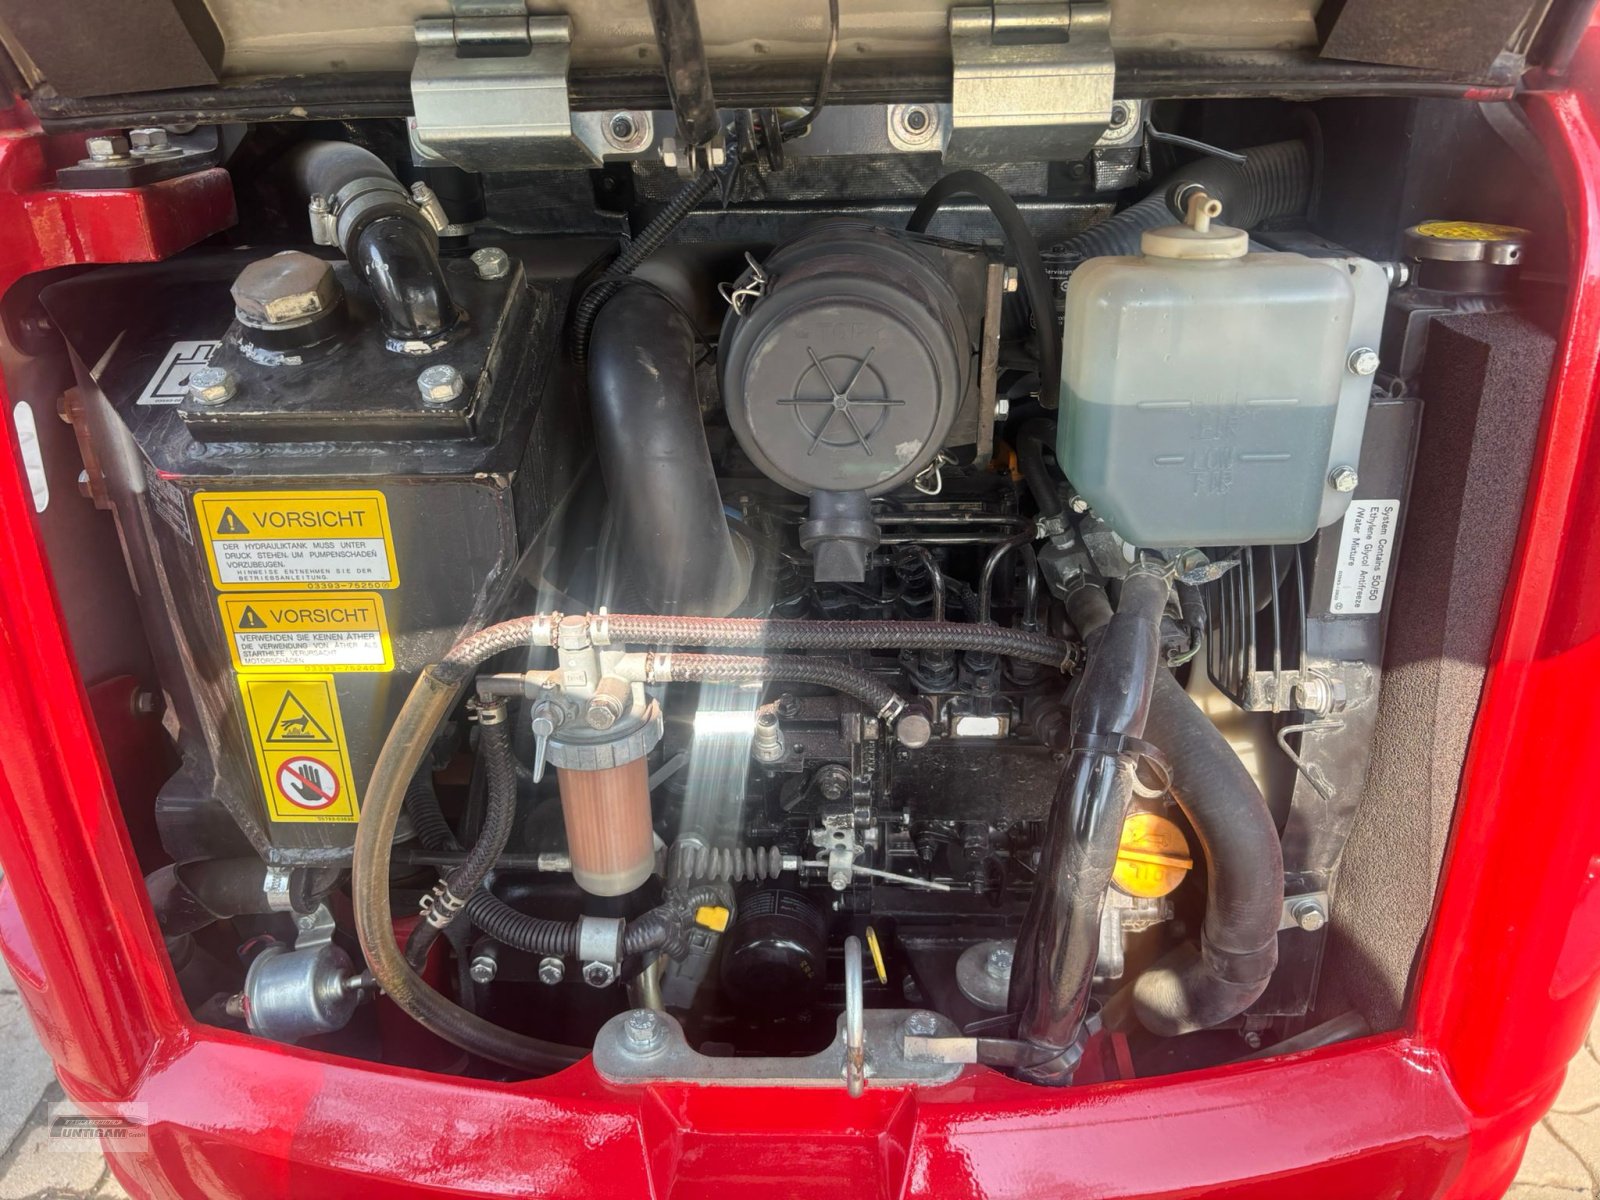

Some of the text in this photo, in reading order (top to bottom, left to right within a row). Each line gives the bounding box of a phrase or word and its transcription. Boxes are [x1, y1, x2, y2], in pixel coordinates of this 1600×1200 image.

[252, 511, 366, 528] VORSICHT
[1348, 507, 1366, 567] /Water Mixture
[222, 542, 240, 550] DER
[244, 542, 308, 550] HYDRAULIKTANK
[1368, 506, 1393, 601] System Contains 50/50
[224, 552, 252, 560] DRUCK
[1354, 506, 1380, 608] Ethylene Glycol Antifreeze
[226, 561, 286, 569] VORZUBEUGEN.
[269, 608, 369, 623] VORSICHT
[240, 634, 293, 642] VERWENDEN
[297, 634, 310, 642] SIE
[1129, 863, 1164, 882] OIL
